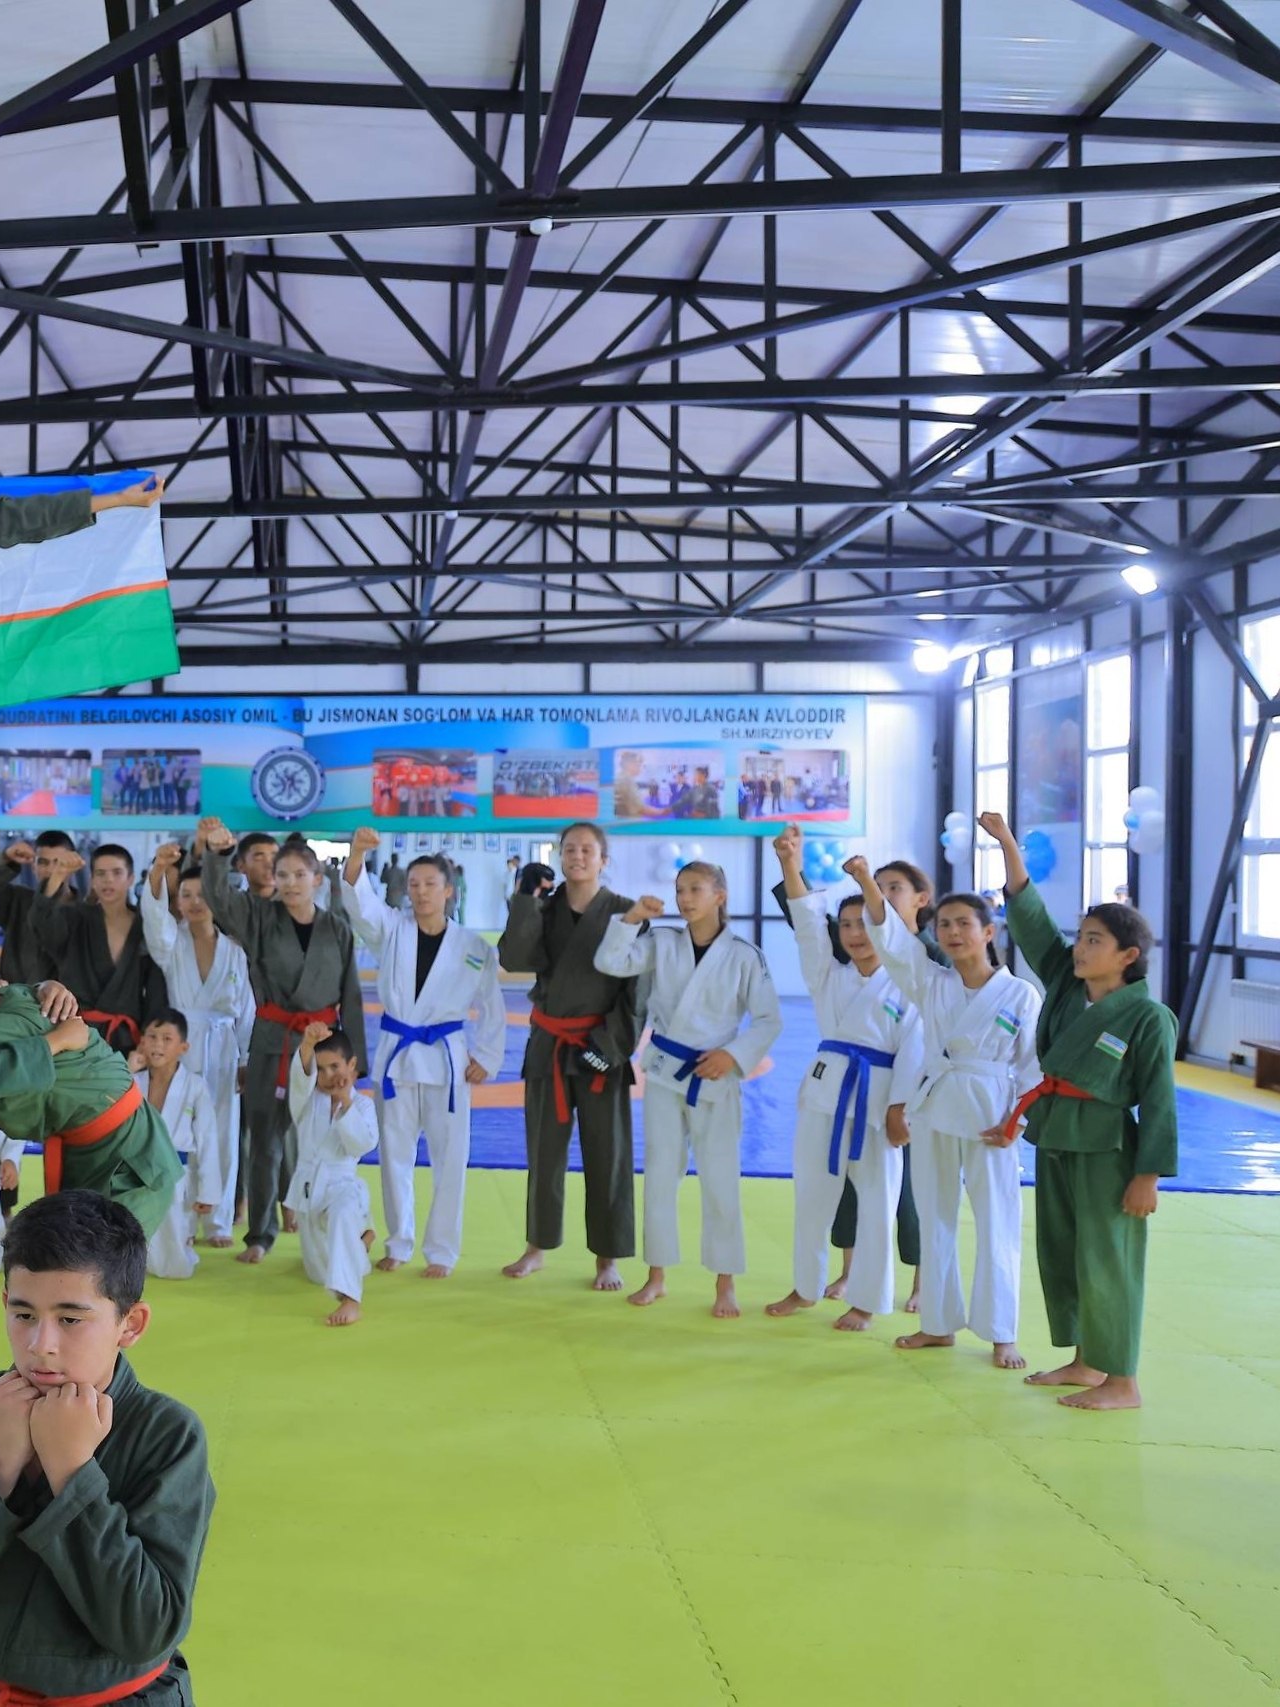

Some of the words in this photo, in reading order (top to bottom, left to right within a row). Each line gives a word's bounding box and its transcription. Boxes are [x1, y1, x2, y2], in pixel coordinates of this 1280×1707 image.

[80, 709, 177, 724] BELGILOVCHI
[182, 709, 236, 723] ASOSIY
[242, 708, 278, 723] OMIL
[318, 708, 397, 723] JISMONAN
[477, 708, 497, 722] VA
[502, 708, 534, 722] HAR
[539, 708, 640, 723] TOMONLAMA
[645, 708, 759, 723] RIVOJLANGAN
[765, 708, 846, 723] AVLODDIR
[721, 728, 834, 740] SH.MIRZIYOYEV
